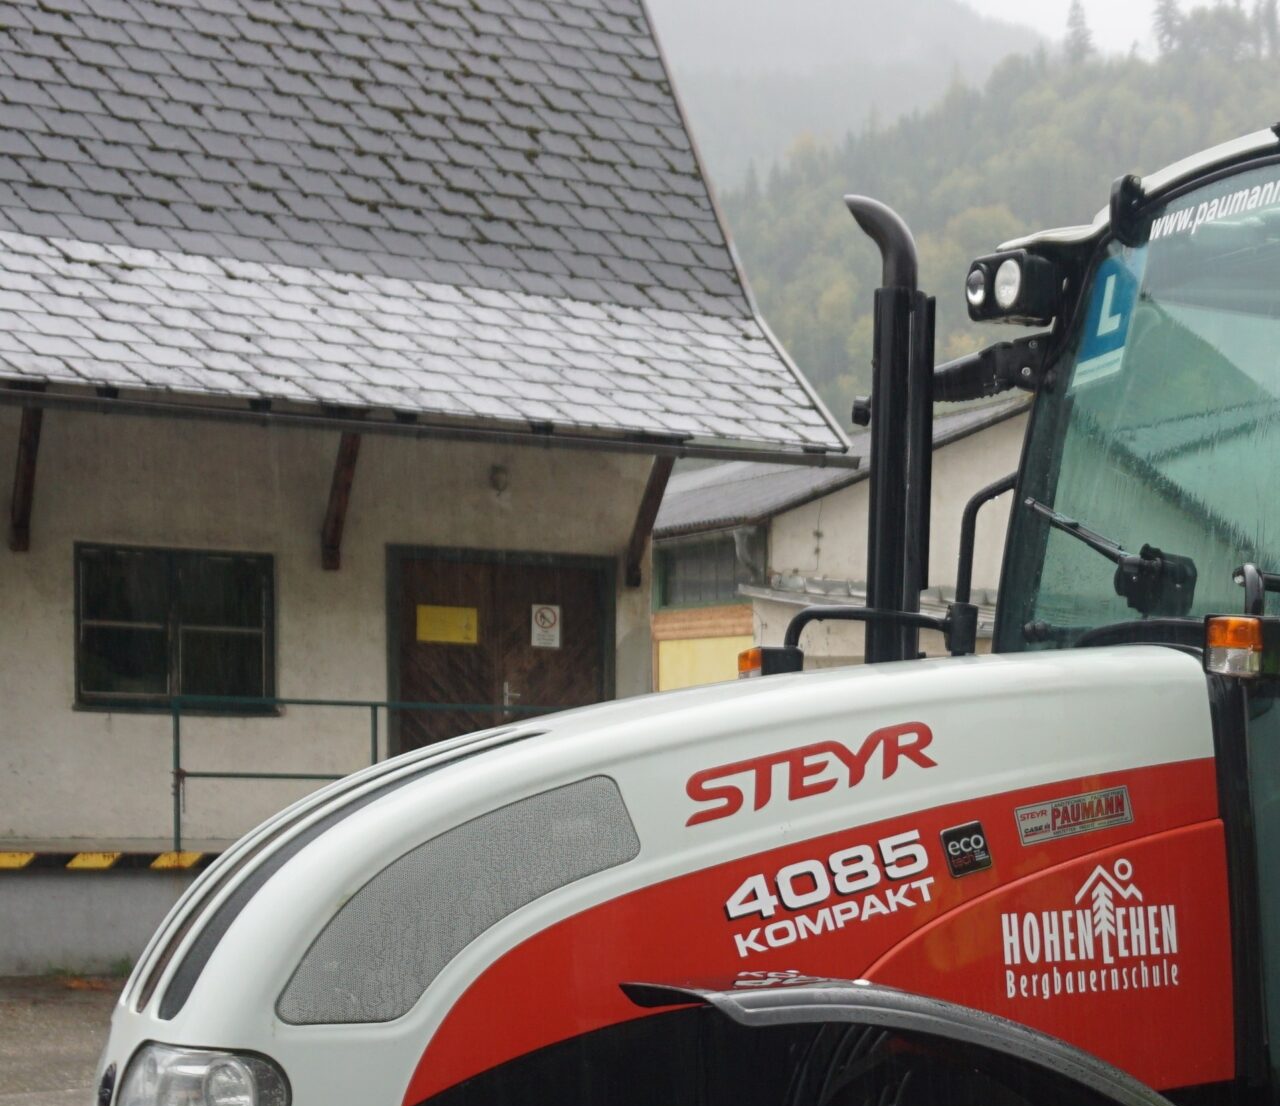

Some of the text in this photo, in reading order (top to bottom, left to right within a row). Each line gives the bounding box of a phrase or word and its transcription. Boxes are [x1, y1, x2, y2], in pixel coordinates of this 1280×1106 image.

[1096, 273, 1122, 337] L
[686, 721, 938, 827] STEYR
[1019, 809, 1048, 821] STEYR
[1051, 794, 1125, 831] PAUMANN
[948, 834, 984, 856] eco
[724, 829, 929, 921] 4085
[734, 876, 935, 958] KOMPAKT
[1005, 958, 1179, 1000] Bergbauernschule
